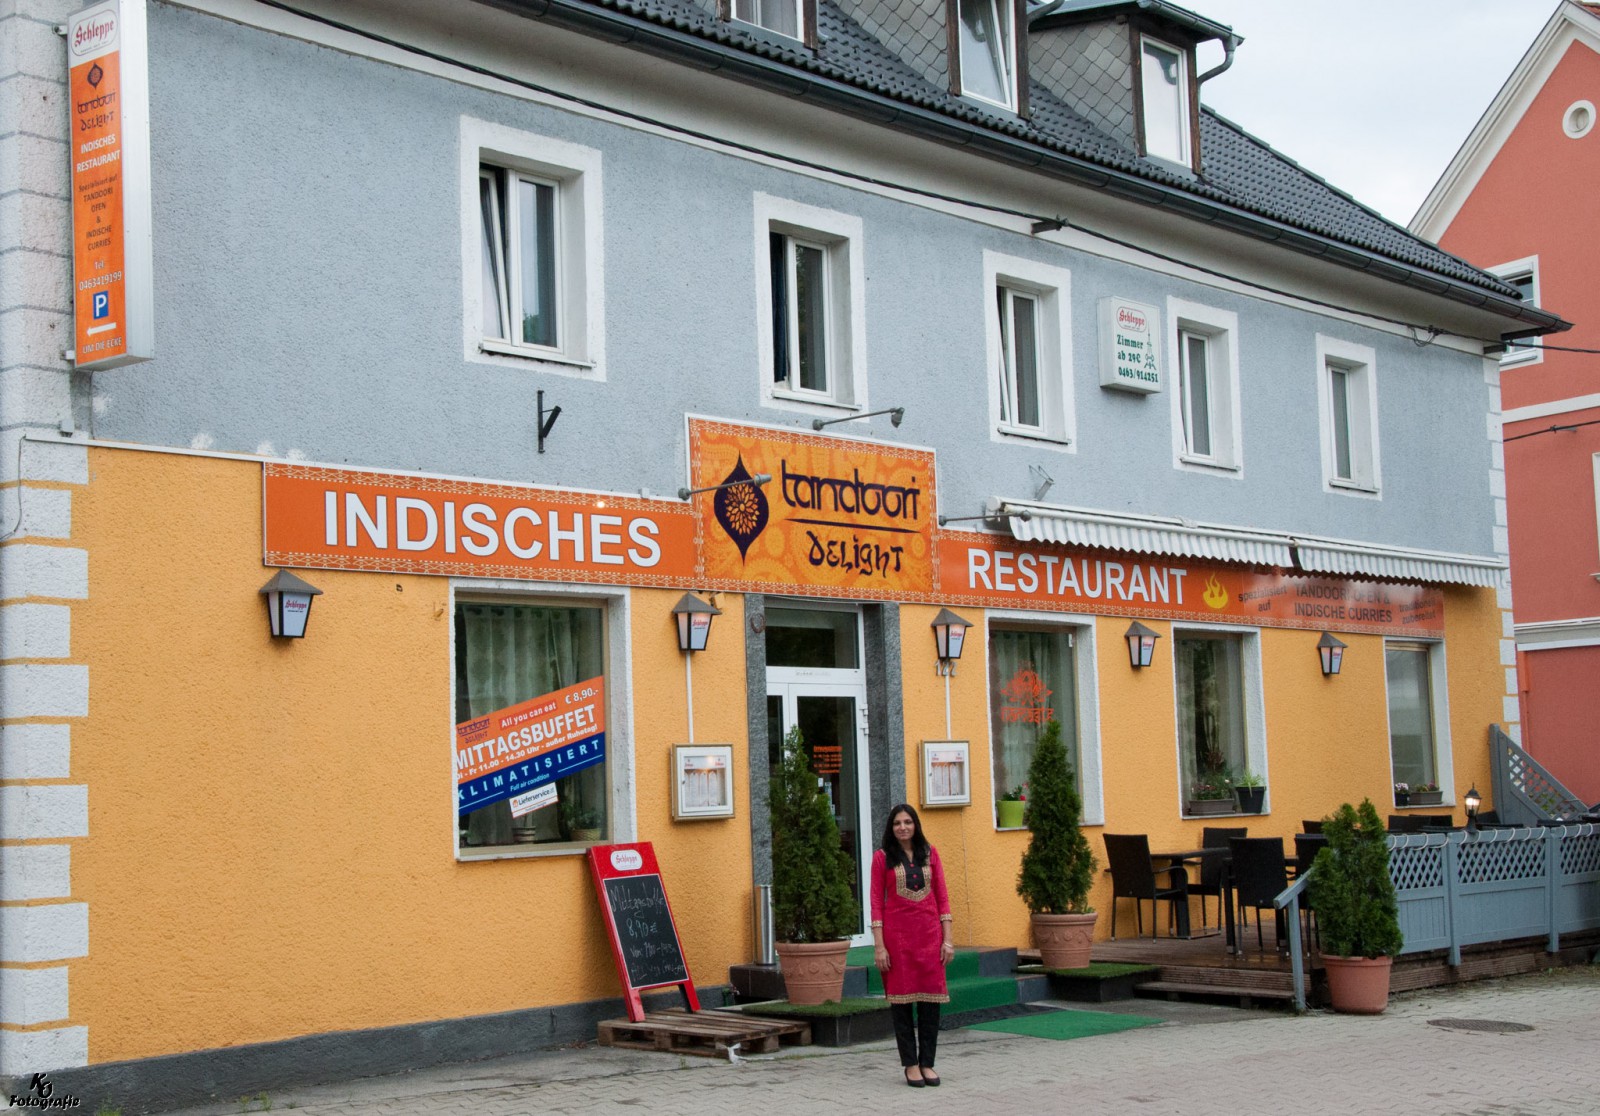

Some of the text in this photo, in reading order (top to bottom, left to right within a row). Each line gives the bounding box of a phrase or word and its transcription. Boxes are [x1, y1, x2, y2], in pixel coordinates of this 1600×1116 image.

[74, 20, 114, 47] Schleppe
[81, 134, 115, 154] INDISCHES
[77, 150, 120, 172] RESTAURANT
[84, 187, 113, 202] TANDOORI
[91, 202, 106, 212] OFEN
[96, 216, 101, 224] &
[86, 225, 112, 238] INDISCHE
[88, 238, 111, 251] CURRIES
[79, 271, 122, 291] 0463419199
[95, 294, 107, 317] P
[1119, 309, 1145, 326] Schleppe
[82, 337, 122, 354] UM DIE ECKE
[1117, 334, 1143, 349] Zimmer
[1118, 350, 1126, 360] ab
[1118, 366, 1158, 383] 0463/914251
[781, 459, 920, 520] tandoori
[324, 490, 662, 568] INDISCHES
[967, 548, 1188, 605] RESTAURANT
[1258, 599, 1271, 612] auf
[1295, 602, 1392, 623] INDISCHE CURRIES
[565, 695, 572, 704] €
[501, 702, 556, 728] All you can eat
[456, 704, 595, 770] MITTAGSBUFFET
[479, 760, 499, 771] 11.00
[506, 750, 525, 762] 14.30
[527, 746, 539, 755] Uhr
[546, 737, 566, 748] außer
[458, 739, 599, 800] KLIMATISIERT
[510, 783, 519, 792] Full
[528, 773, 550, 785] condition
